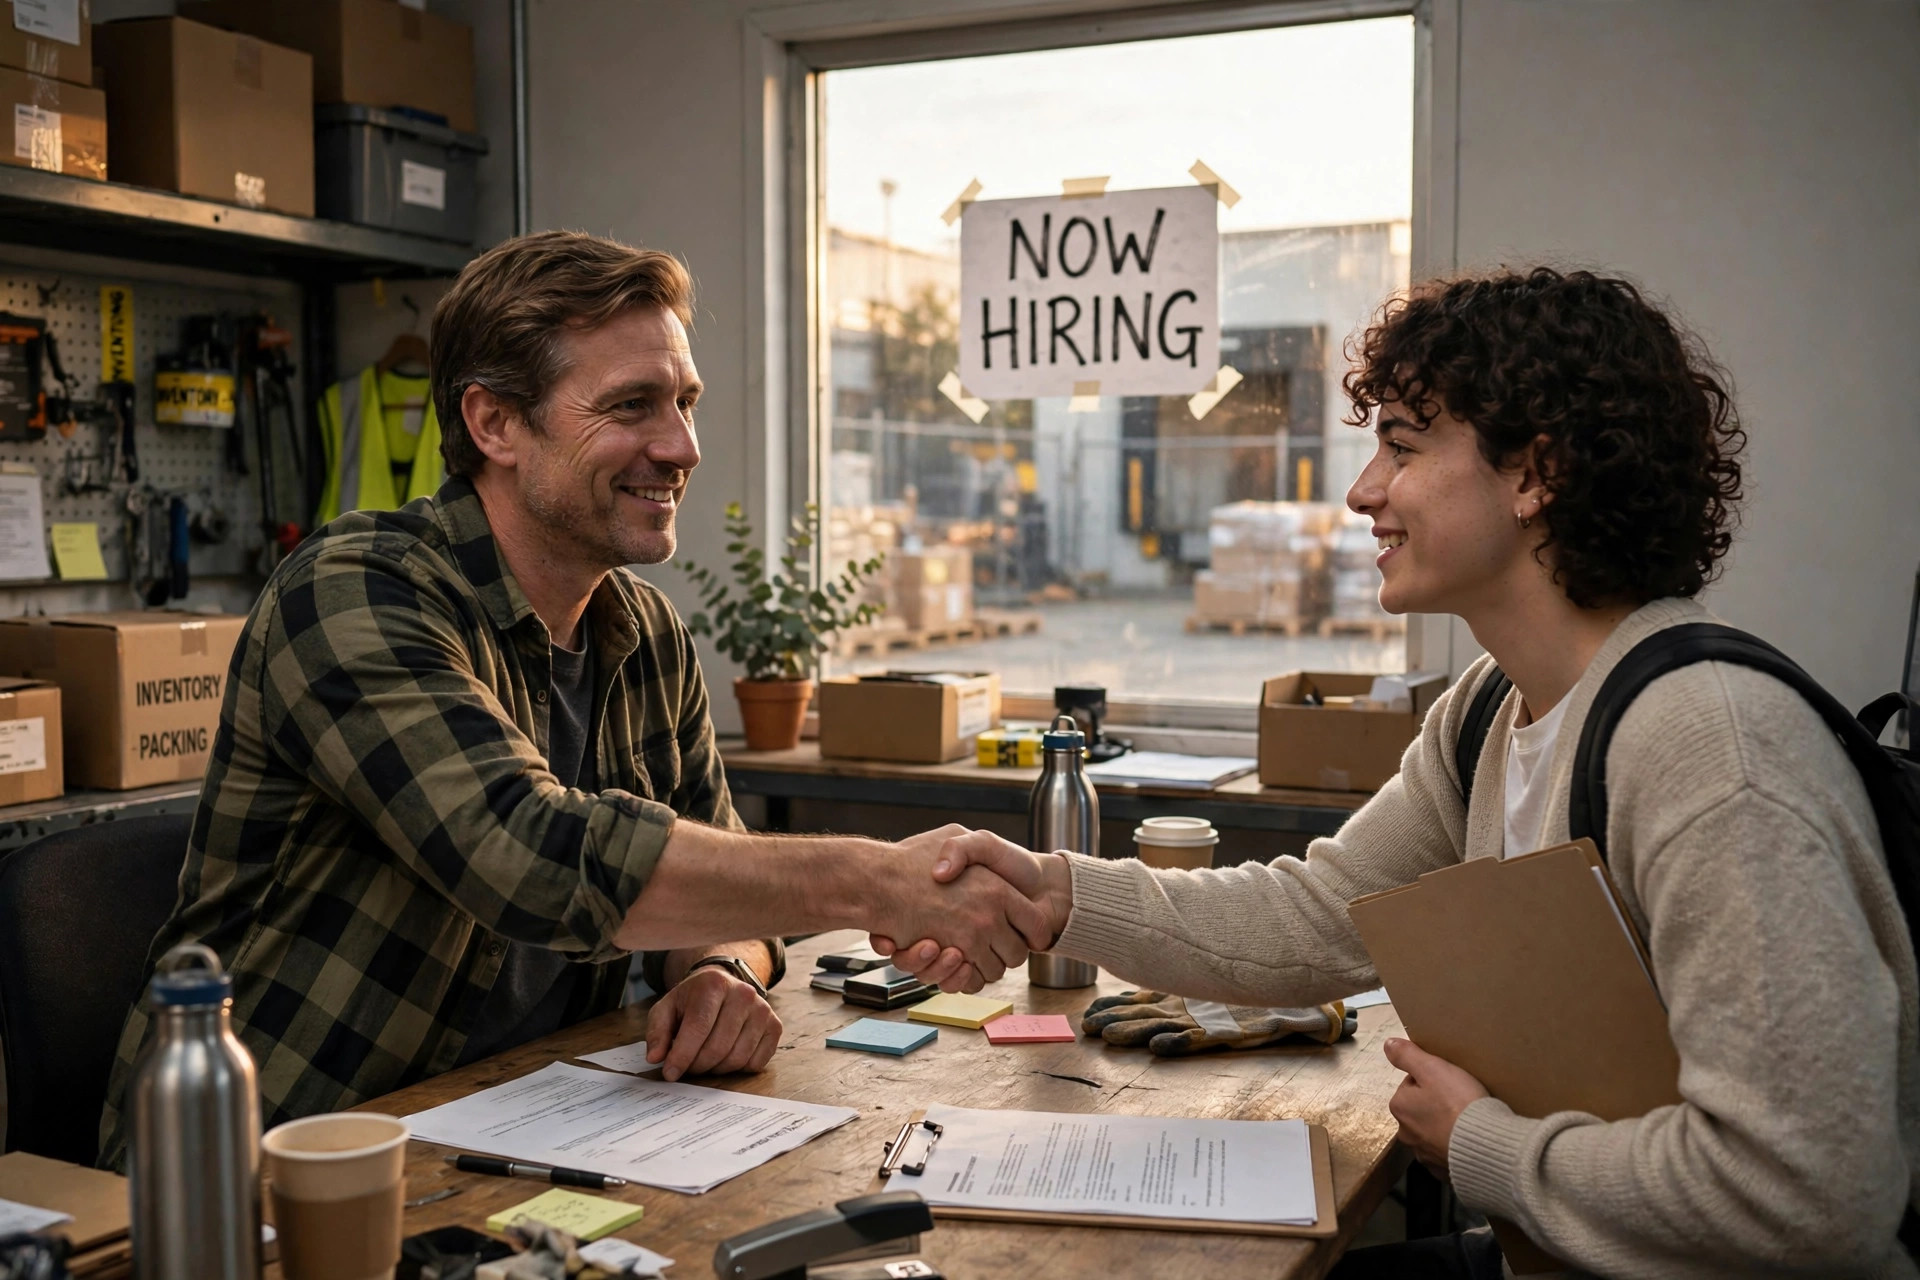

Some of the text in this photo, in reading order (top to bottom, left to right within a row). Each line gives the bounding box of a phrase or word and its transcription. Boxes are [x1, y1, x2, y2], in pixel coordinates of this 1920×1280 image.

[1009, 207, 1165, 281] NOW
[981, 289, 1203, 369] HIRING
[136, 674, 221, 707] INVENTORY
[140, 727, 208, 760] PACKING
